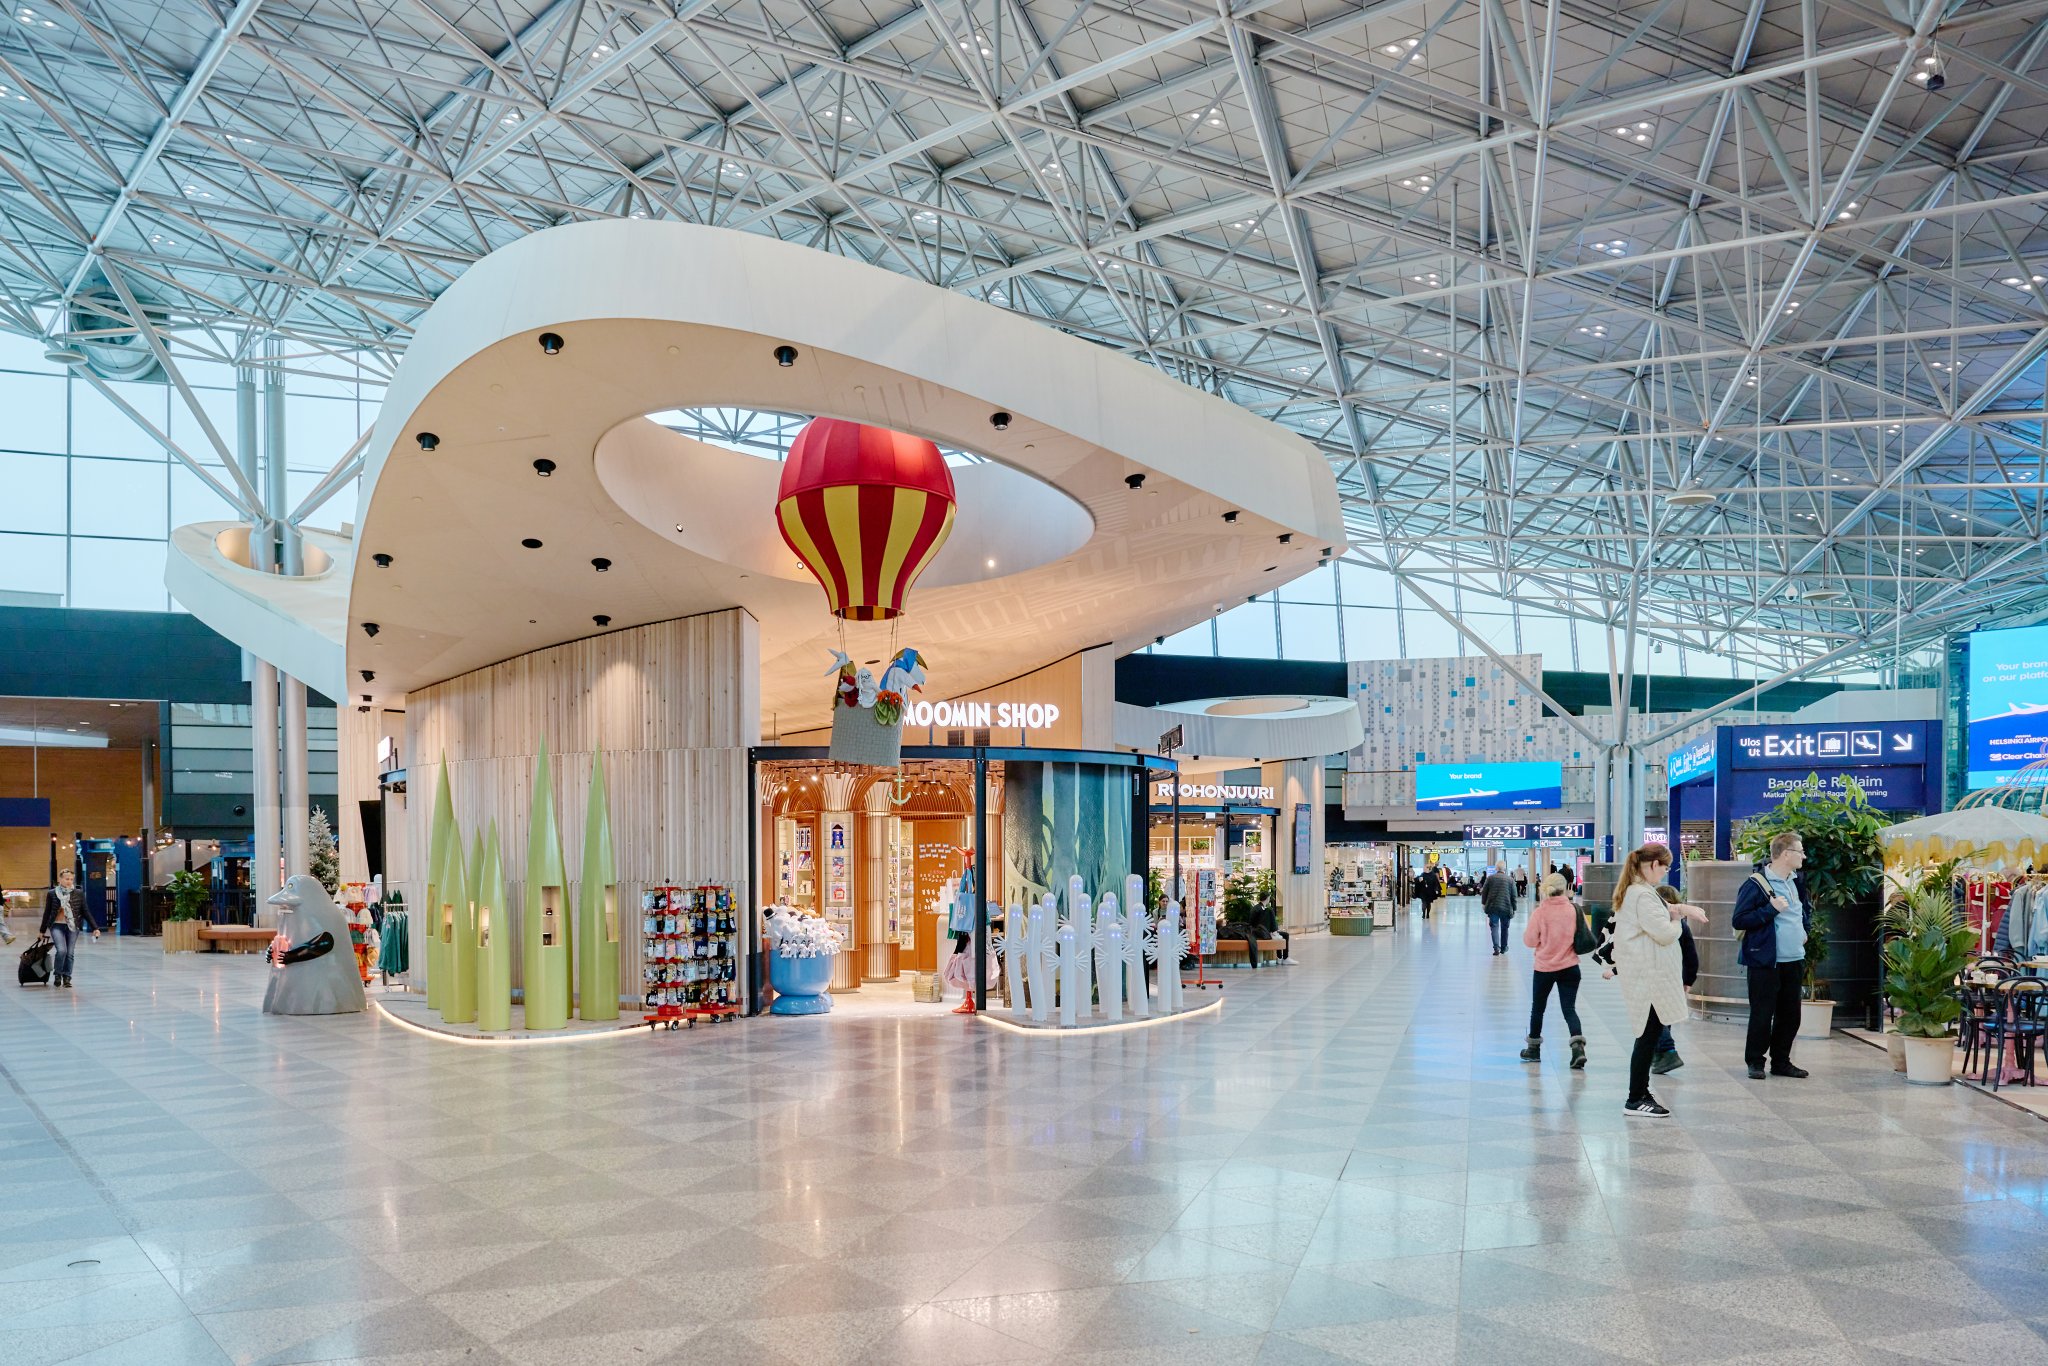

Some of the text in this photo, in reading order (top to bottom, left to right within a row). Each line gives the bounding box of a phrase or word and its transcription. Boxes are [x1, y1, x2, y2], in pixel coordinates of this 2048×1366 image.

[1996, 661, 2048, 671] Your bran
[1999, 673, 2016, 681] our
[2019, 670, 2048, 681] platfo
[903, 700, 1059, 728] MOOMIN SHOP
[1740, 738, 1761, 747] Ulos
[1764, 733, 1815, 756] Exit
[1748, 748, 1761, 756] Ut
[1831, 776, 1883, 788] Relaim
[1157, 783, 1274, 800] RUOHONJUURI
[1484, 826, 1520, 838] 22-25
[1553, 826, 1579, 837] 1-21
